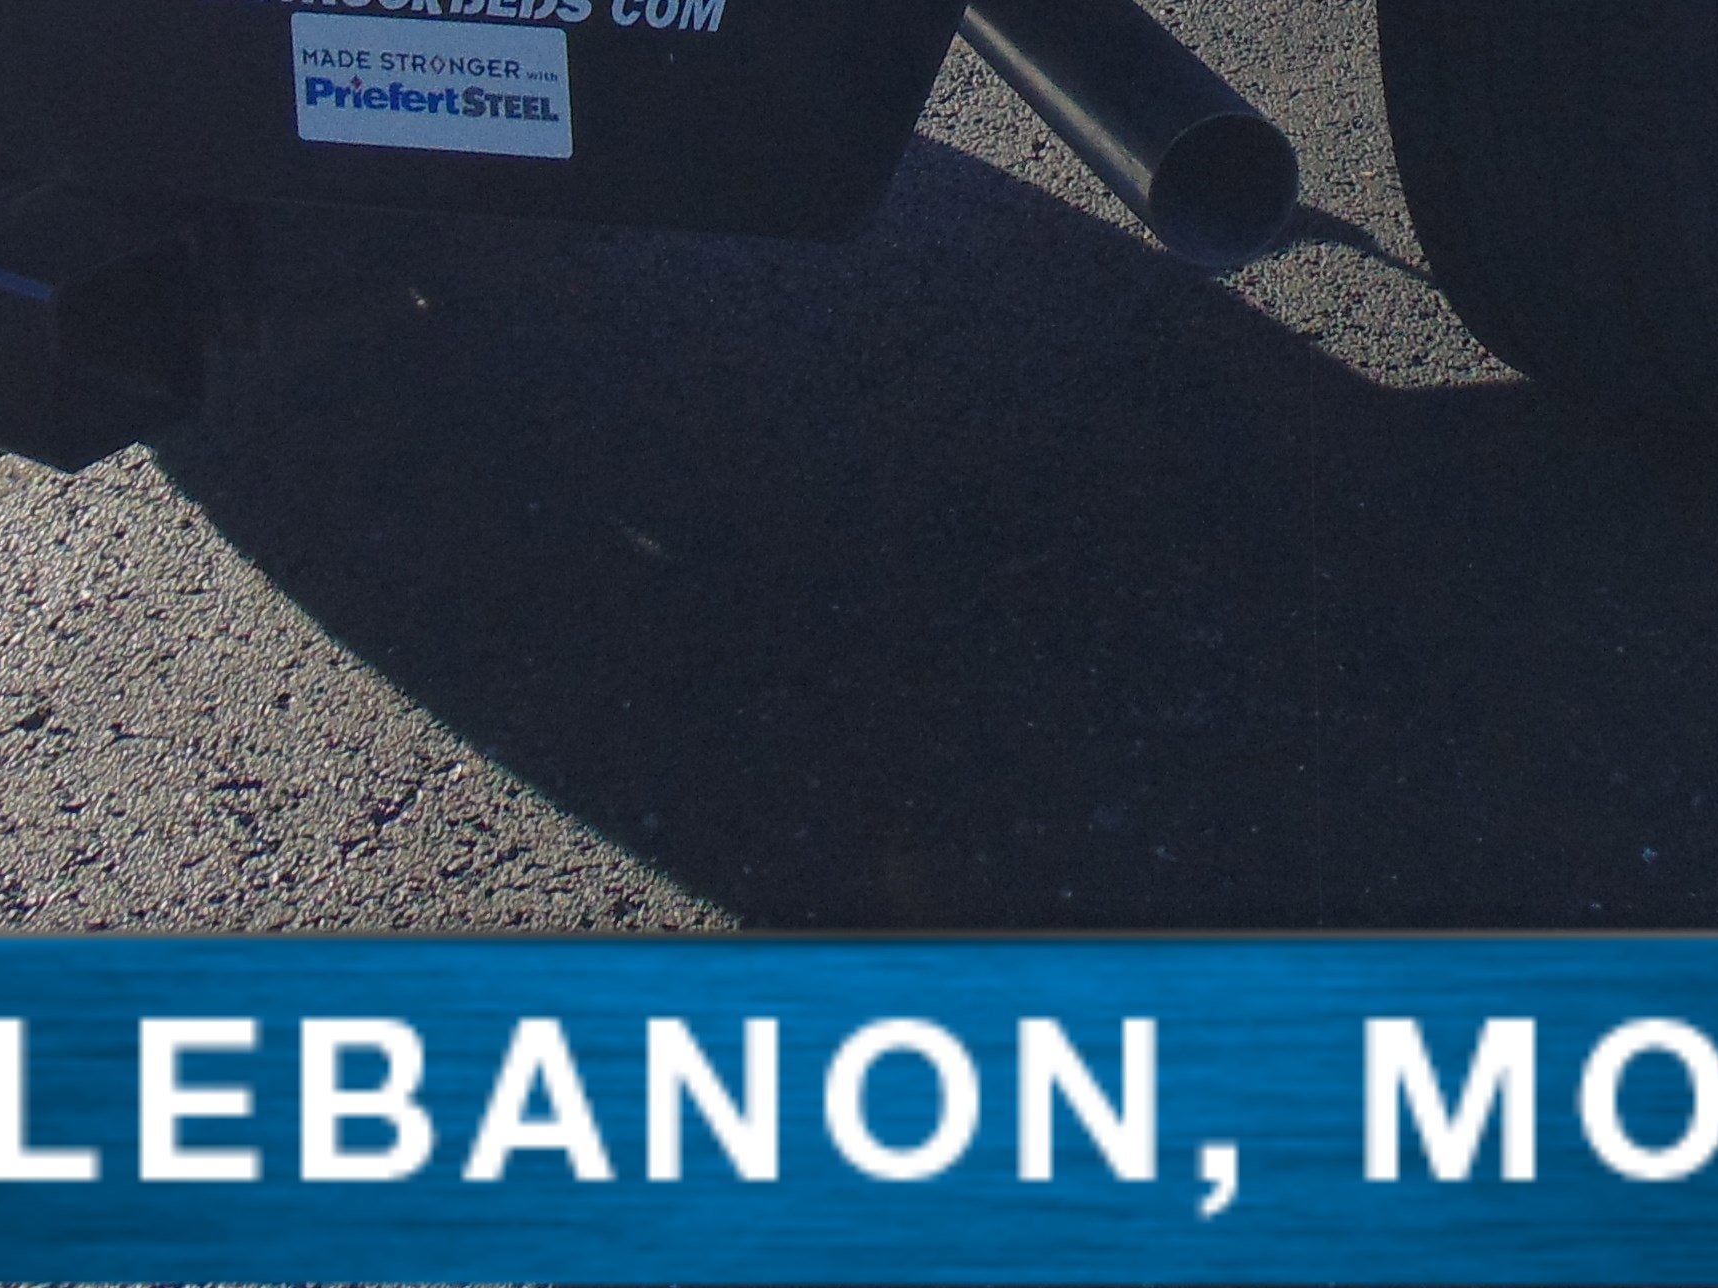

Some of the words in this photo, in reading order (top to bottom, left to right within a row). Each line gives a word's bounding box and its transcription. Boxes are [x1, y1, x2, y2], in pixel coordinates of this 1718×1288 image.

[301, 48, 372, 70] MADE
[379, 52, 520, 80] STRONGER
[525, 70, 559, 83] with
